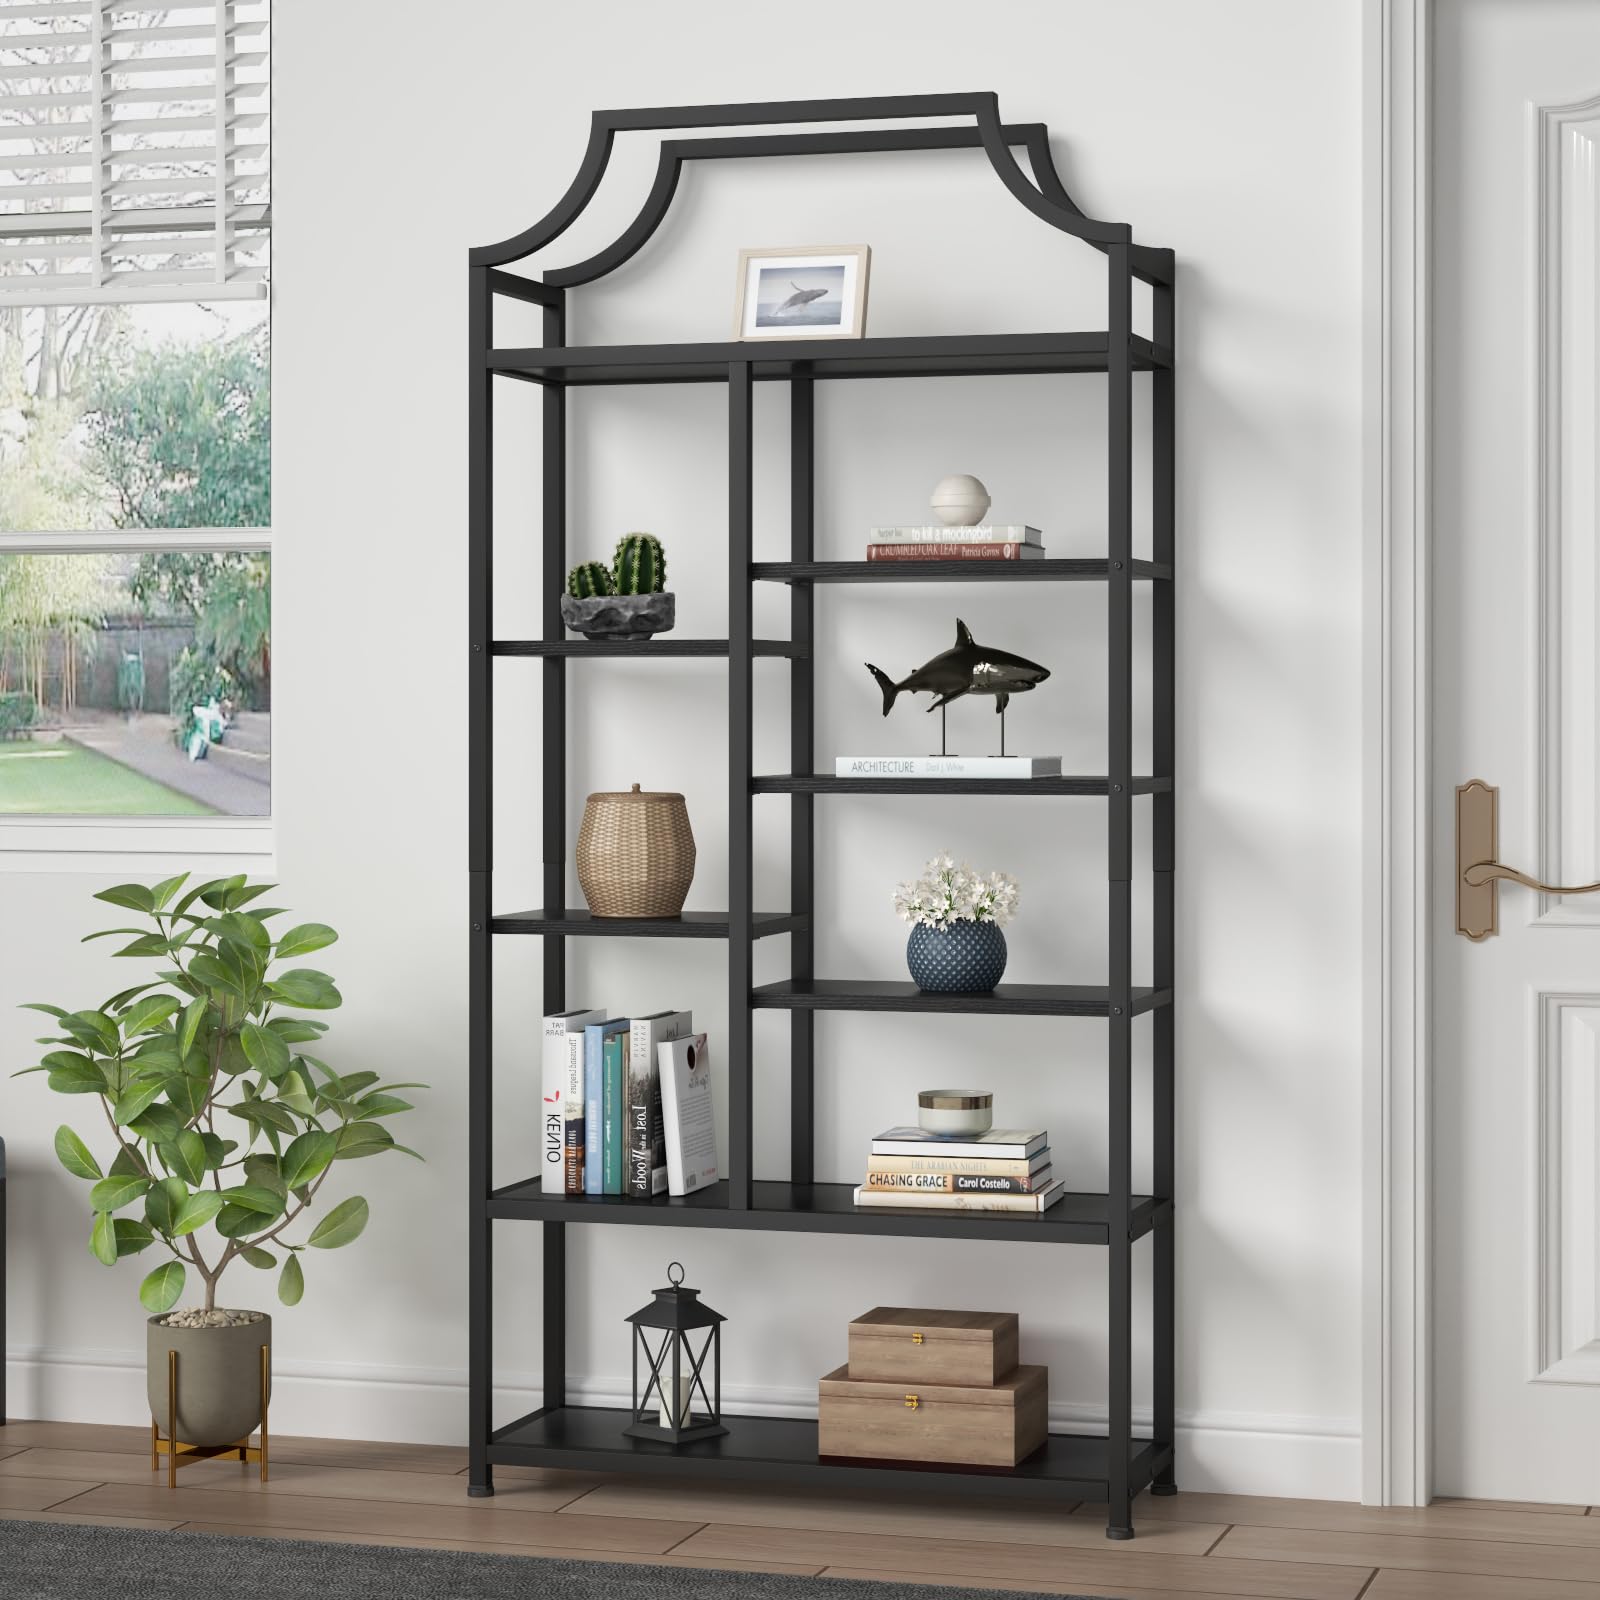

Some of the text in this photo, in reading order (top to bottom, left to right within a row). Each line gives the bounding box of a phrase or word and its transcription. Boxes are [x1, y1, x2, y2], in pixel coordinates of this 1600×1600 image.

[912, 527, 920, 541] to
[923, 526, 933, 540] kill
[935, 529, 940, 541] a
[942, 526, 992, 543] mockingbird
[921, 543, 938, 556] OAK
[940, 543, 957, 556] LEAF
[852, 761, 914, 773] ARCHITECTURE
[869, 1173, 1010, 1190] CHASING GRACE Carol Costello
